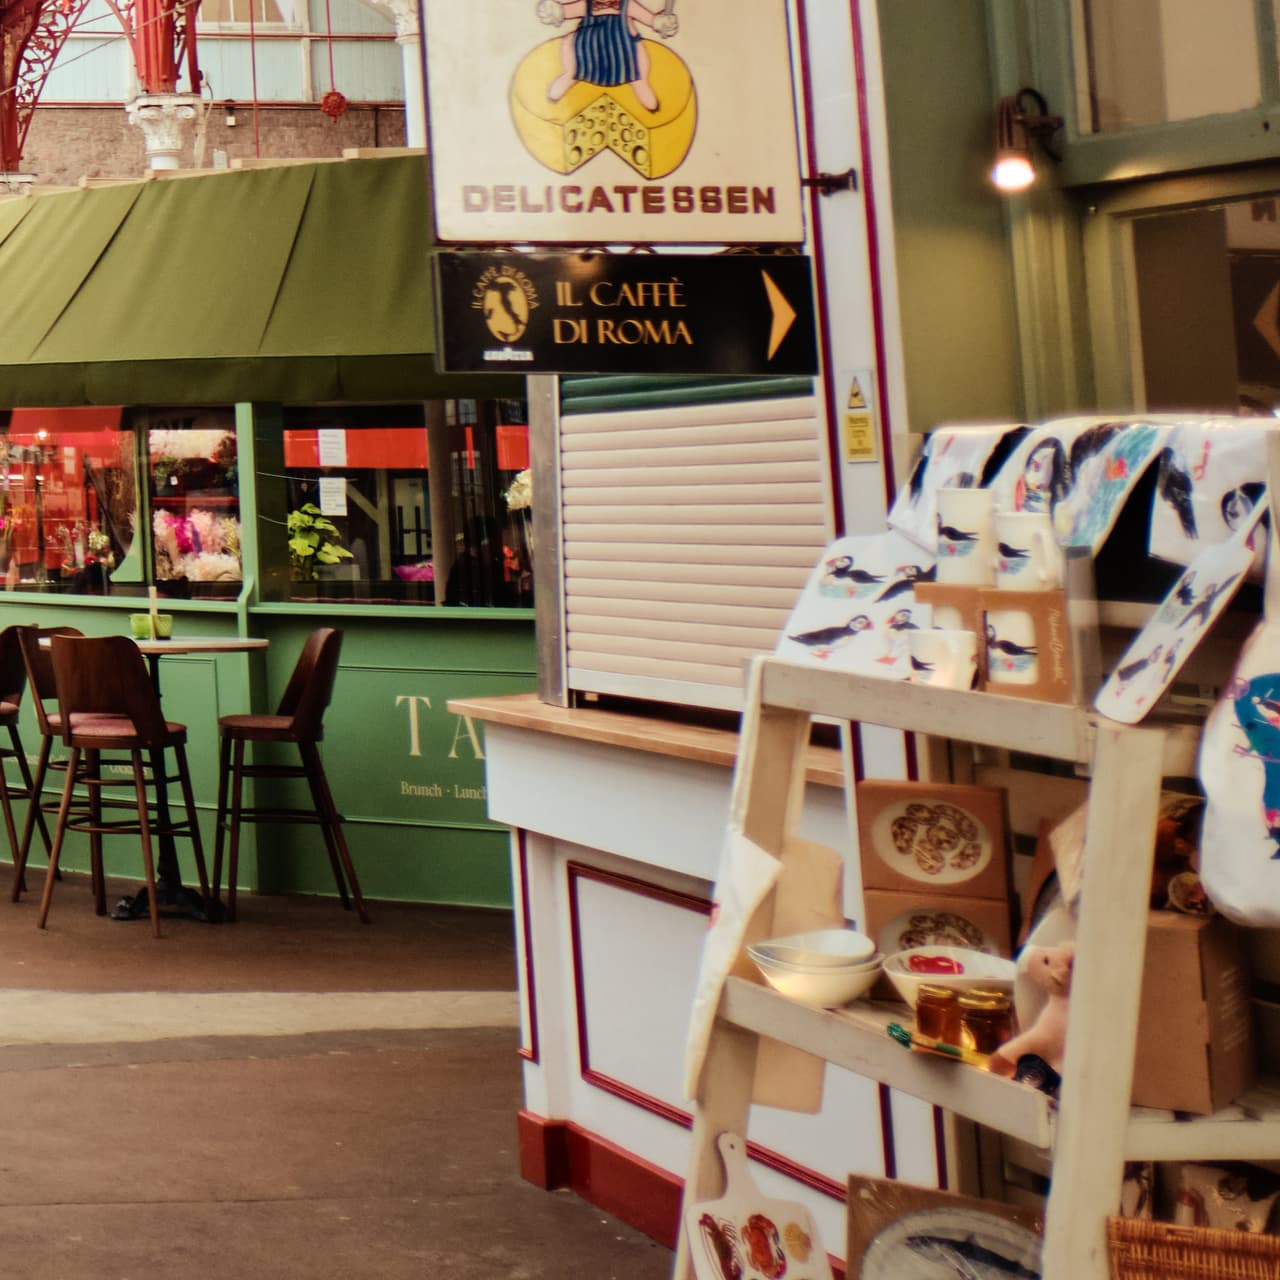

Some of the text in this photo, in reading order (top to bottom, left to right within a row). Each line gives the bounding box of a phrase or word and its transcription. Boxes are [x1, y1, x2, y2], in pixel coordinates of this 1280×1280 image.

[461, 184, 777, 215] DELICATESSEN
[554, 276, 688, 308] IL CAFFÈ
[552, 319, 694, 345] DI ROMA
[401, 780, 442, 797] Brunch
